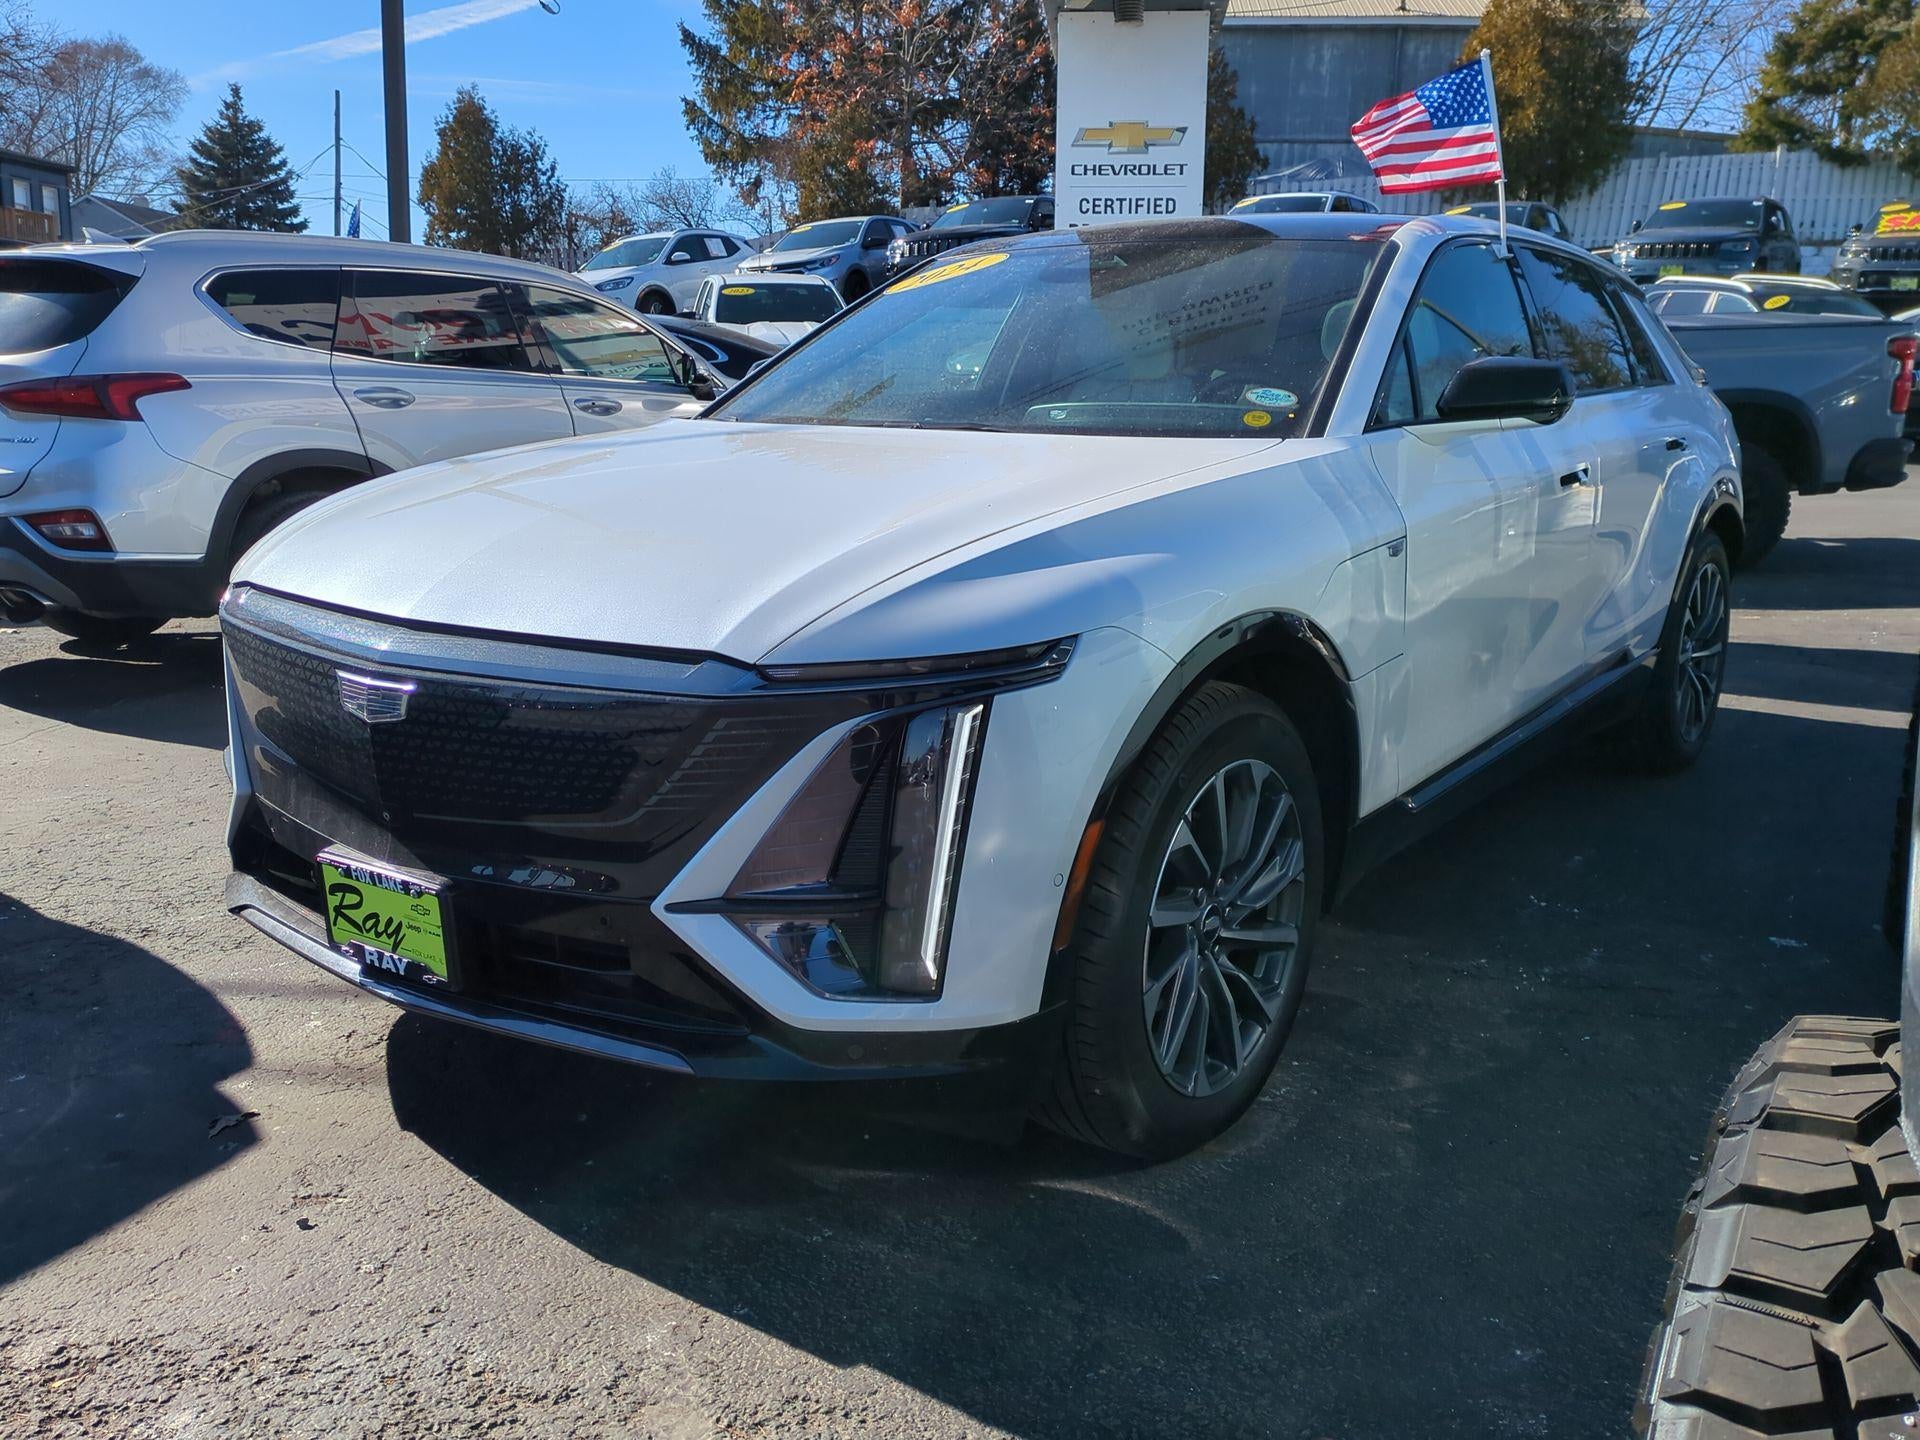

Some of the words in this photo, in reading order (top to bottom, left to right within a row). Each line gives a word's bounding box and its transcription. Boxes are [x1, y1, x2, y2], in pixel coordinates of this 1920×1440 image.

[1070, 163, 1188, 176] CHEVROLET
[1078, 197, 1177, 214] CERTIFIED
[351, 868, 374, 886] FOX
[374, 872, 405, 894] LAKE
[328, 882, 407, 955] Ray
[364, 947, 407, 975] RAY
